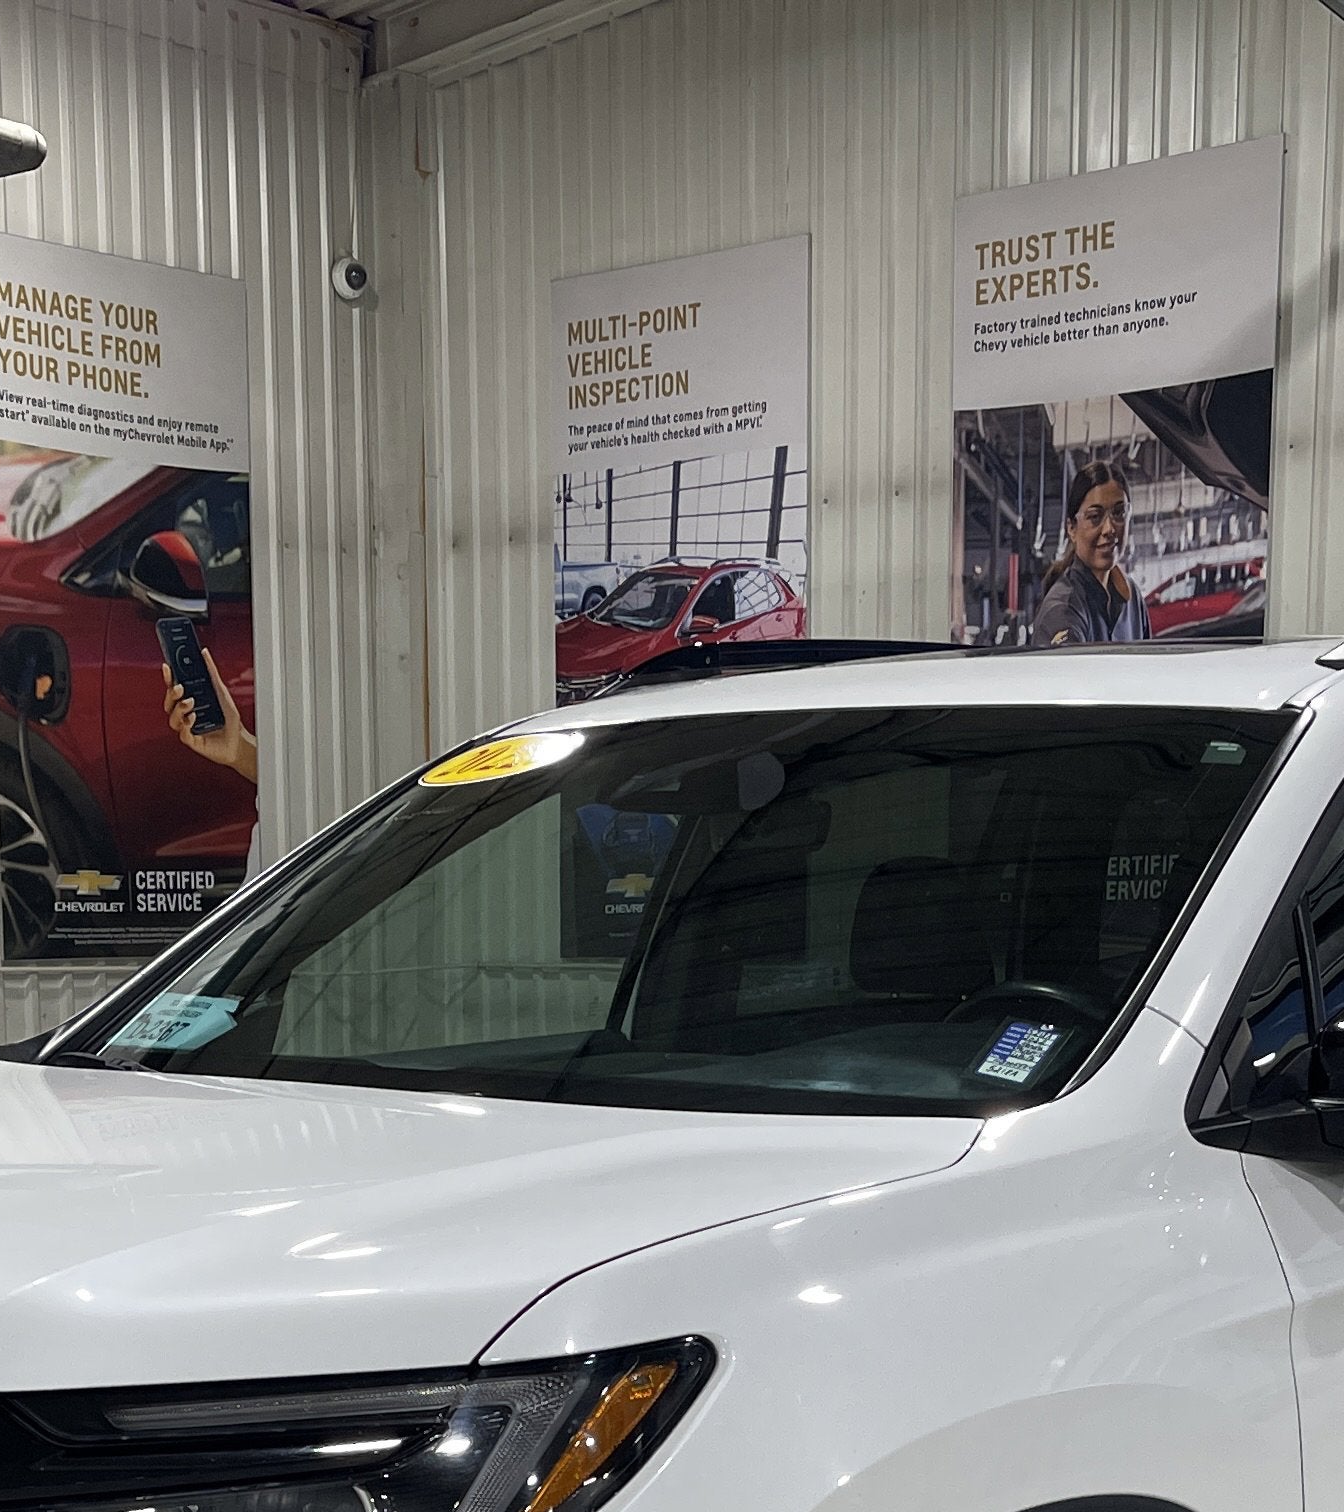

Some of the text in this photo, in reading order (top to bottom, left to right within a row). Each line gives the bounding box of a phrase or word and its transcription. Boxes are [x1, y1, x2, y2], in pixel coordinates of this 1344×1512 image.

[975, 220, 1115, 270] TRUST THE
[975, 262, 1099, 306] EXPERTS.
[99, 300, 158, 336] YOUR
[568, 302, 701, 346] MULTI-POINT
[974, 291, 1197, 335] Factory trained technicians know your
[101, 335, 161, 368] FROM
[974, 316, 1169, 353] Chevy vehicle better than anyone.
[567, 343, 652, 378] VEHICLE
[67, 360, 149, 399] PHONE.
[568, 370, 689, 410] INSPECTION
[26, 396, 75, 414] real-time
[77, 403, 134, 424] diagnostics
[137, 414, 155, 427] and
[157, 417, 183, 432] enjoy
[185, 421, 219, 434] remote
[31, 414, 76, 431] available
[79, 422, 92, 433] on
[94, 423, 111, 436] the
[113, 427, 175, 446] myChevrolet
[177, 434, 207, 449] Mobile
[568, 400, 767, 438] The peace of mind that comes from getting
[568, 441, 588, 456] your
[591, 434, 629, 450] vehicle's
[630, 430, 660, 445] health
[662, 424, 701, 441] checked
[703, 421, 725, 435] with
[726, 422, 733, 432] a
[135, 871, 214, 890] CERTIFIED
[1106, 879, 1168, 900] ERVIC
[54, 901, 125, 912] CHEVROLET
[136, 893, 202, 912] SERVICE
